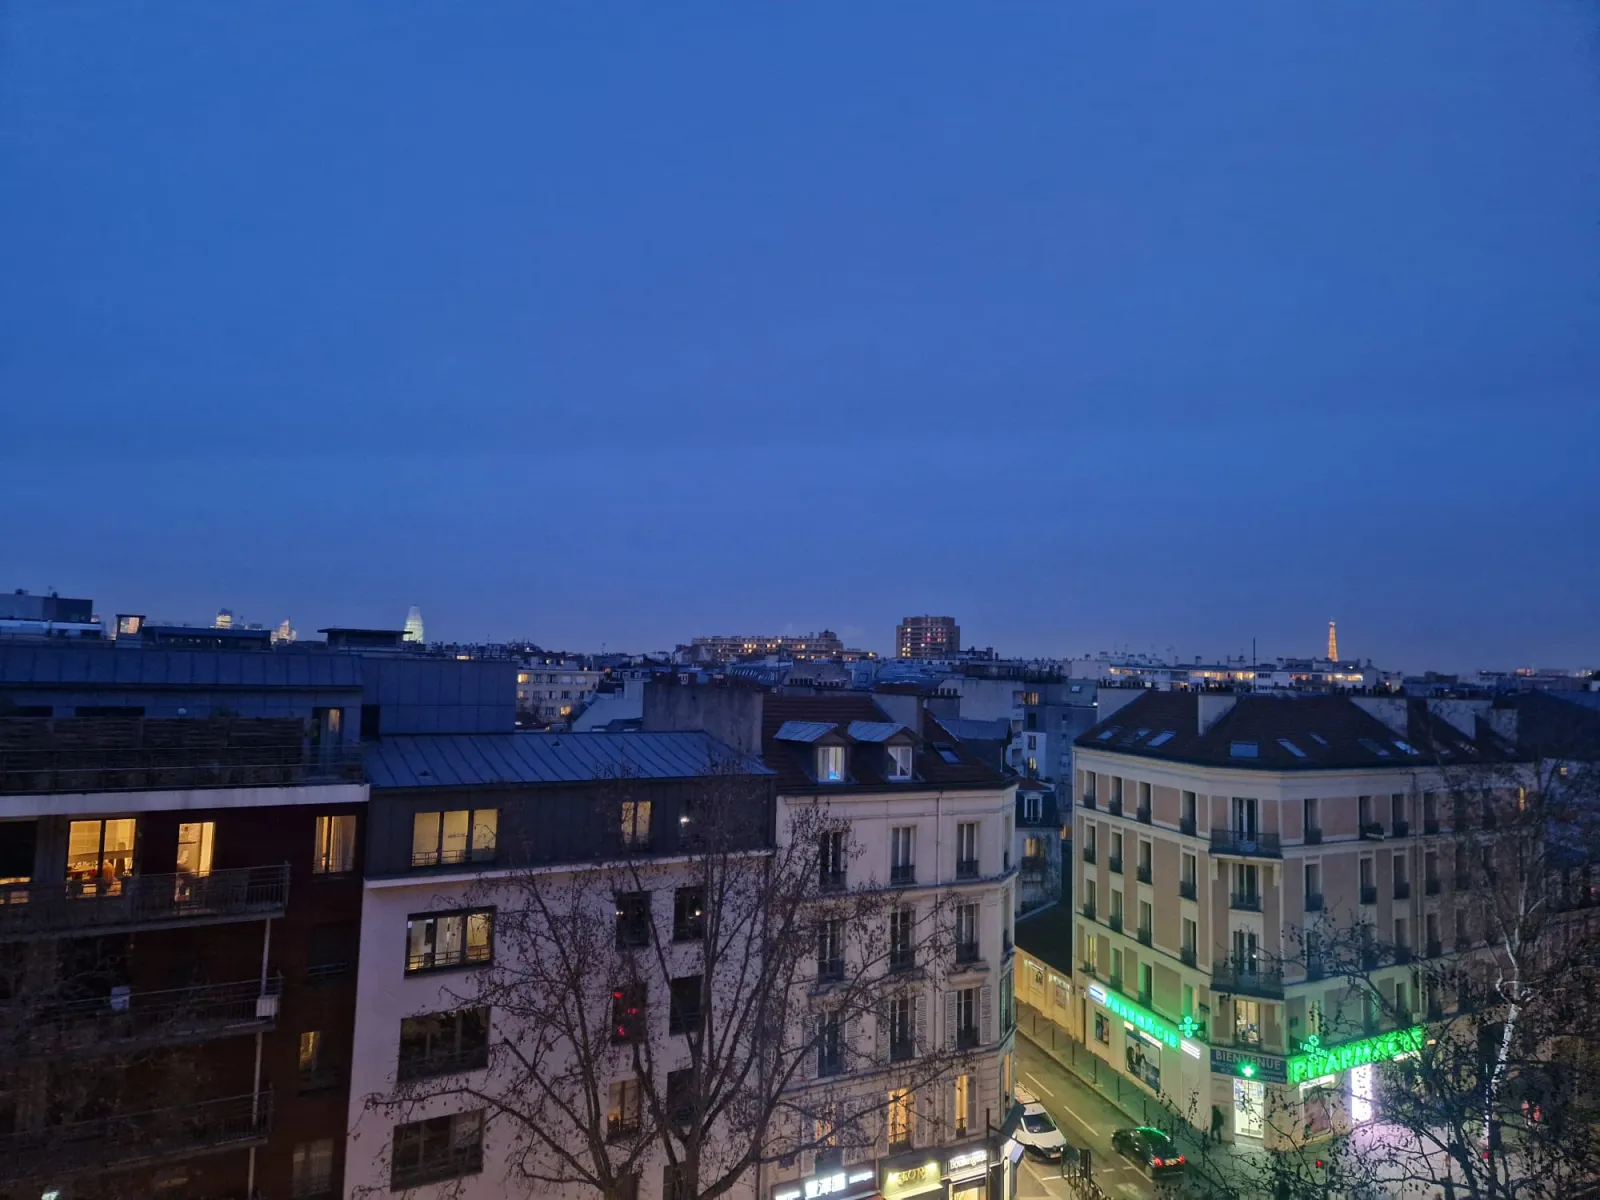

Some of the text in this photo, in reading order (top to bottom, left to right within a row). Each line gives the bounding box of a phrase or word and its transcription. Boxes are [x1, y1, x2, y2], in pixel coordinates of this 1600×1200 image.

[1105, 996, 1177, 1048] PHARMACIE
[1216, 1050, 1281, 1070] BIENVENUE
[1292, 1028, 1423, 1083] PHARMACIE
